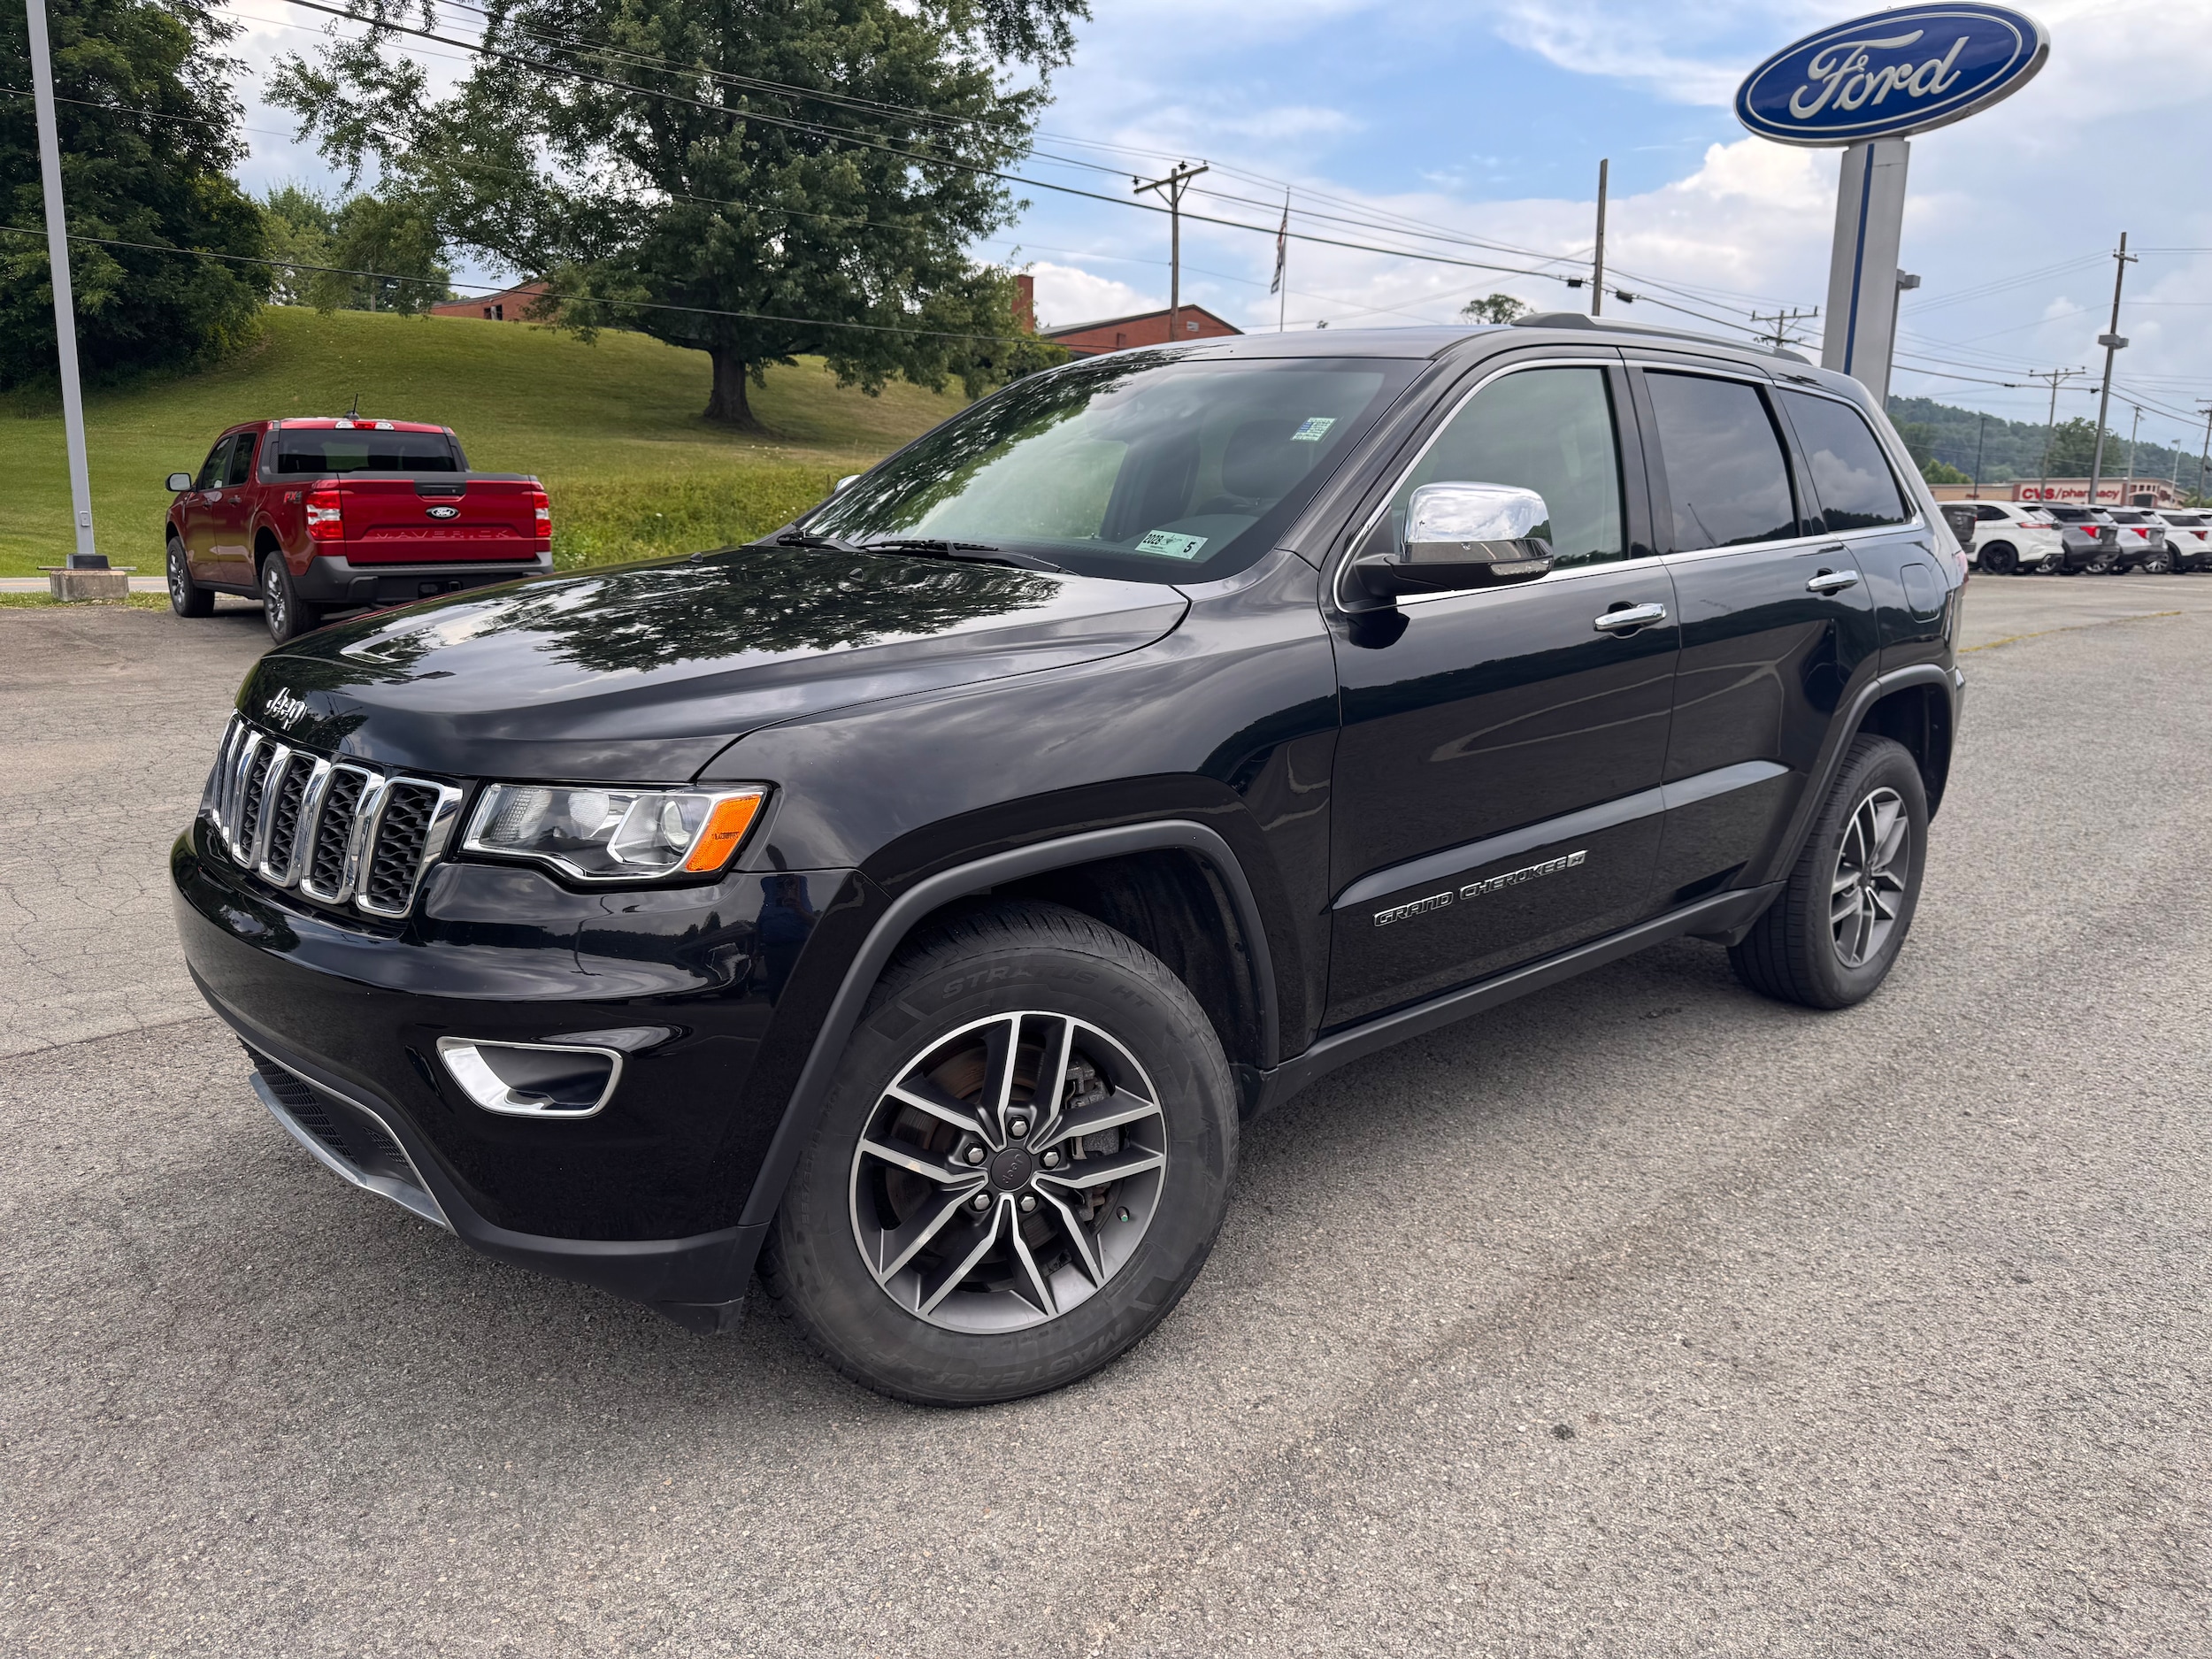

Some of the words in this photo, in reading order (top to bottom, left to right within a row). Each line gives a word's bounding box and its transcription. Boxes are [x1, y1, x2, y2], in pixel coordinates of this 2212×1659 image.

[1789, 29, 1970, 119] Ford
[283, 491, 303, 503] FX4
[1183, 541, 1196, 553] 5
[265, 687, 307, 731] Jeep
[1373, 891, 1453, 927] GRAND
[1459, 856, 1567, 900] CHEROKEE
[941, 964, 1099, 999] STRATUS
[1002, 1153, 1024, 1183] Jeep
